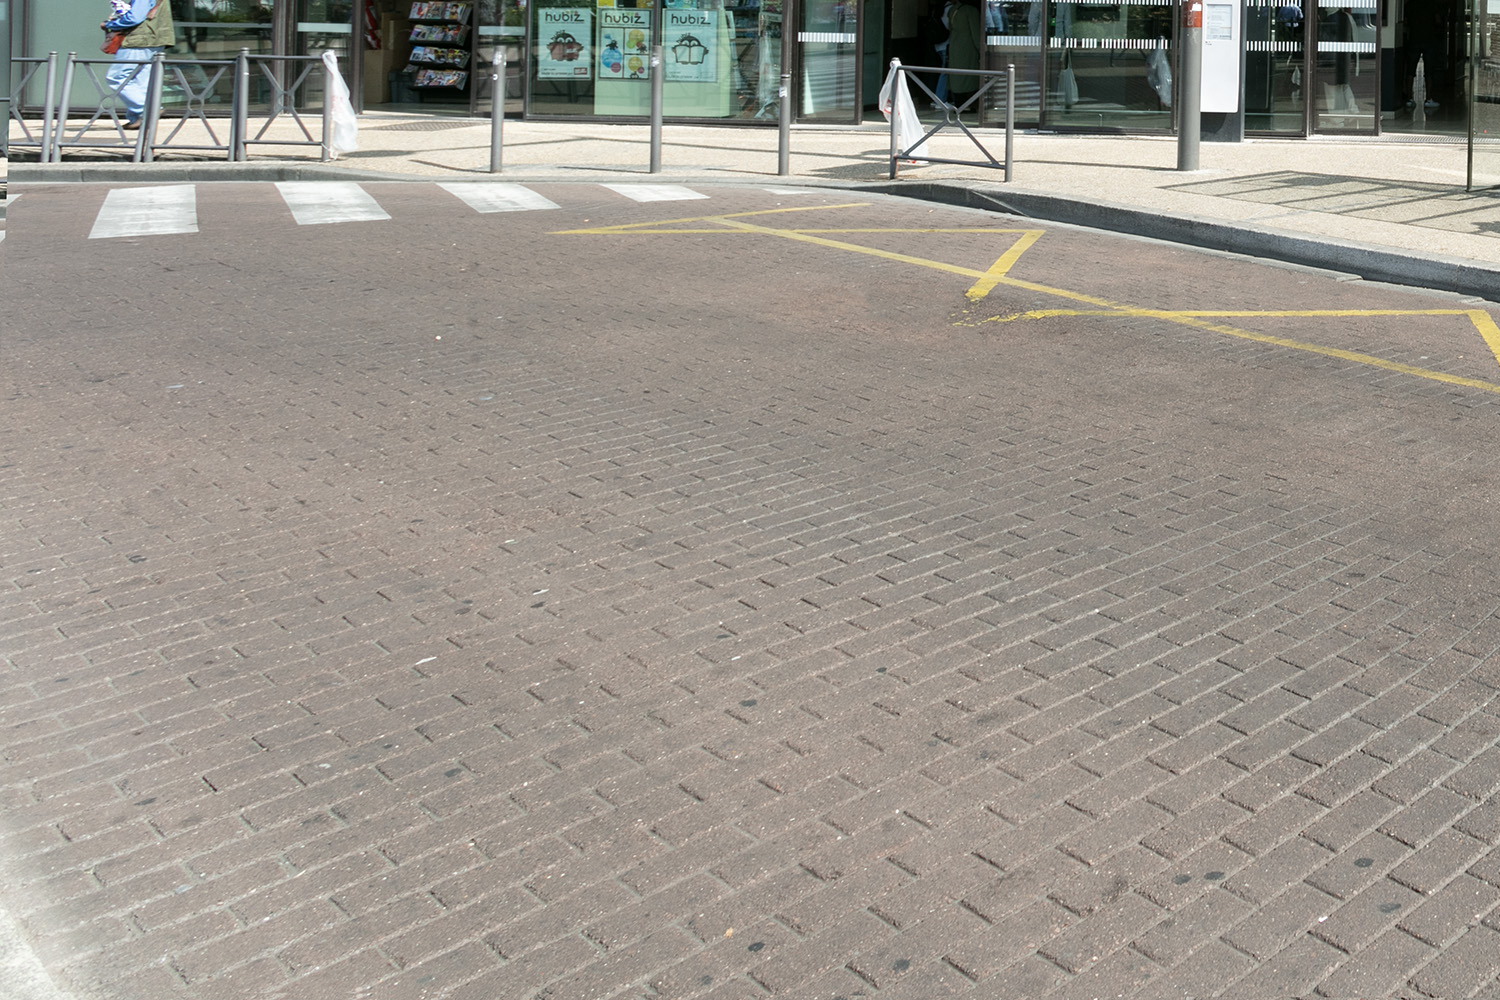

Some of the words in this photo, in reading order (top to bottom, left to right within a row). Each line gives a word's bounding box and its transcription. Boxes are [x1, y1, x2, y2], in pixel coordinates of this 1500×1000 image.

[545, 11, 584, 22] hubiz
[604, 12, 645, 24] hubiz
[671, 13, 711, 25] hubiz
